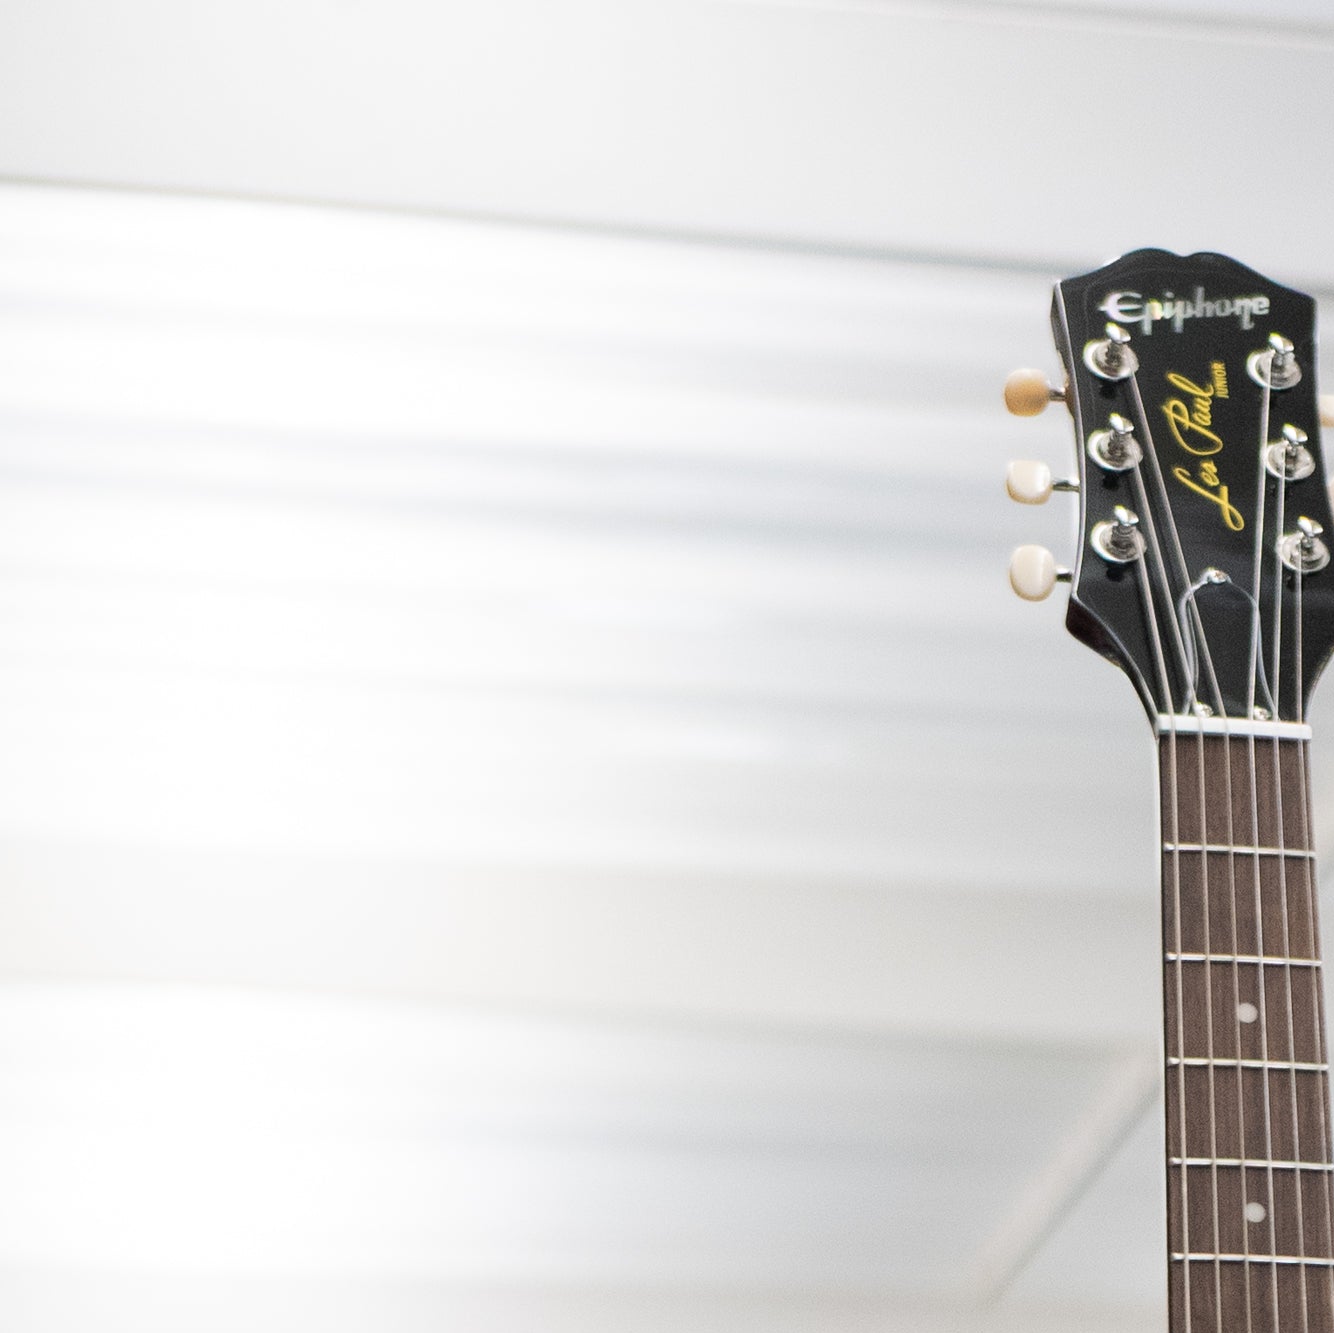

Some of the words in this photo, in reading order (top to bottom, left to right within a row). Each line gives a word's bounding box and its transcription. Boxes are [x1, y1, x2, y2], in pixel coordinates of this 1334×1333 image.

[1100, 286, 1270, 336] Epiphone
[1211, 360, 1230, 400] JUNIOR
[1162, 372, 1224, 456] Paul
[1172, 460, 1245, 532] Les
